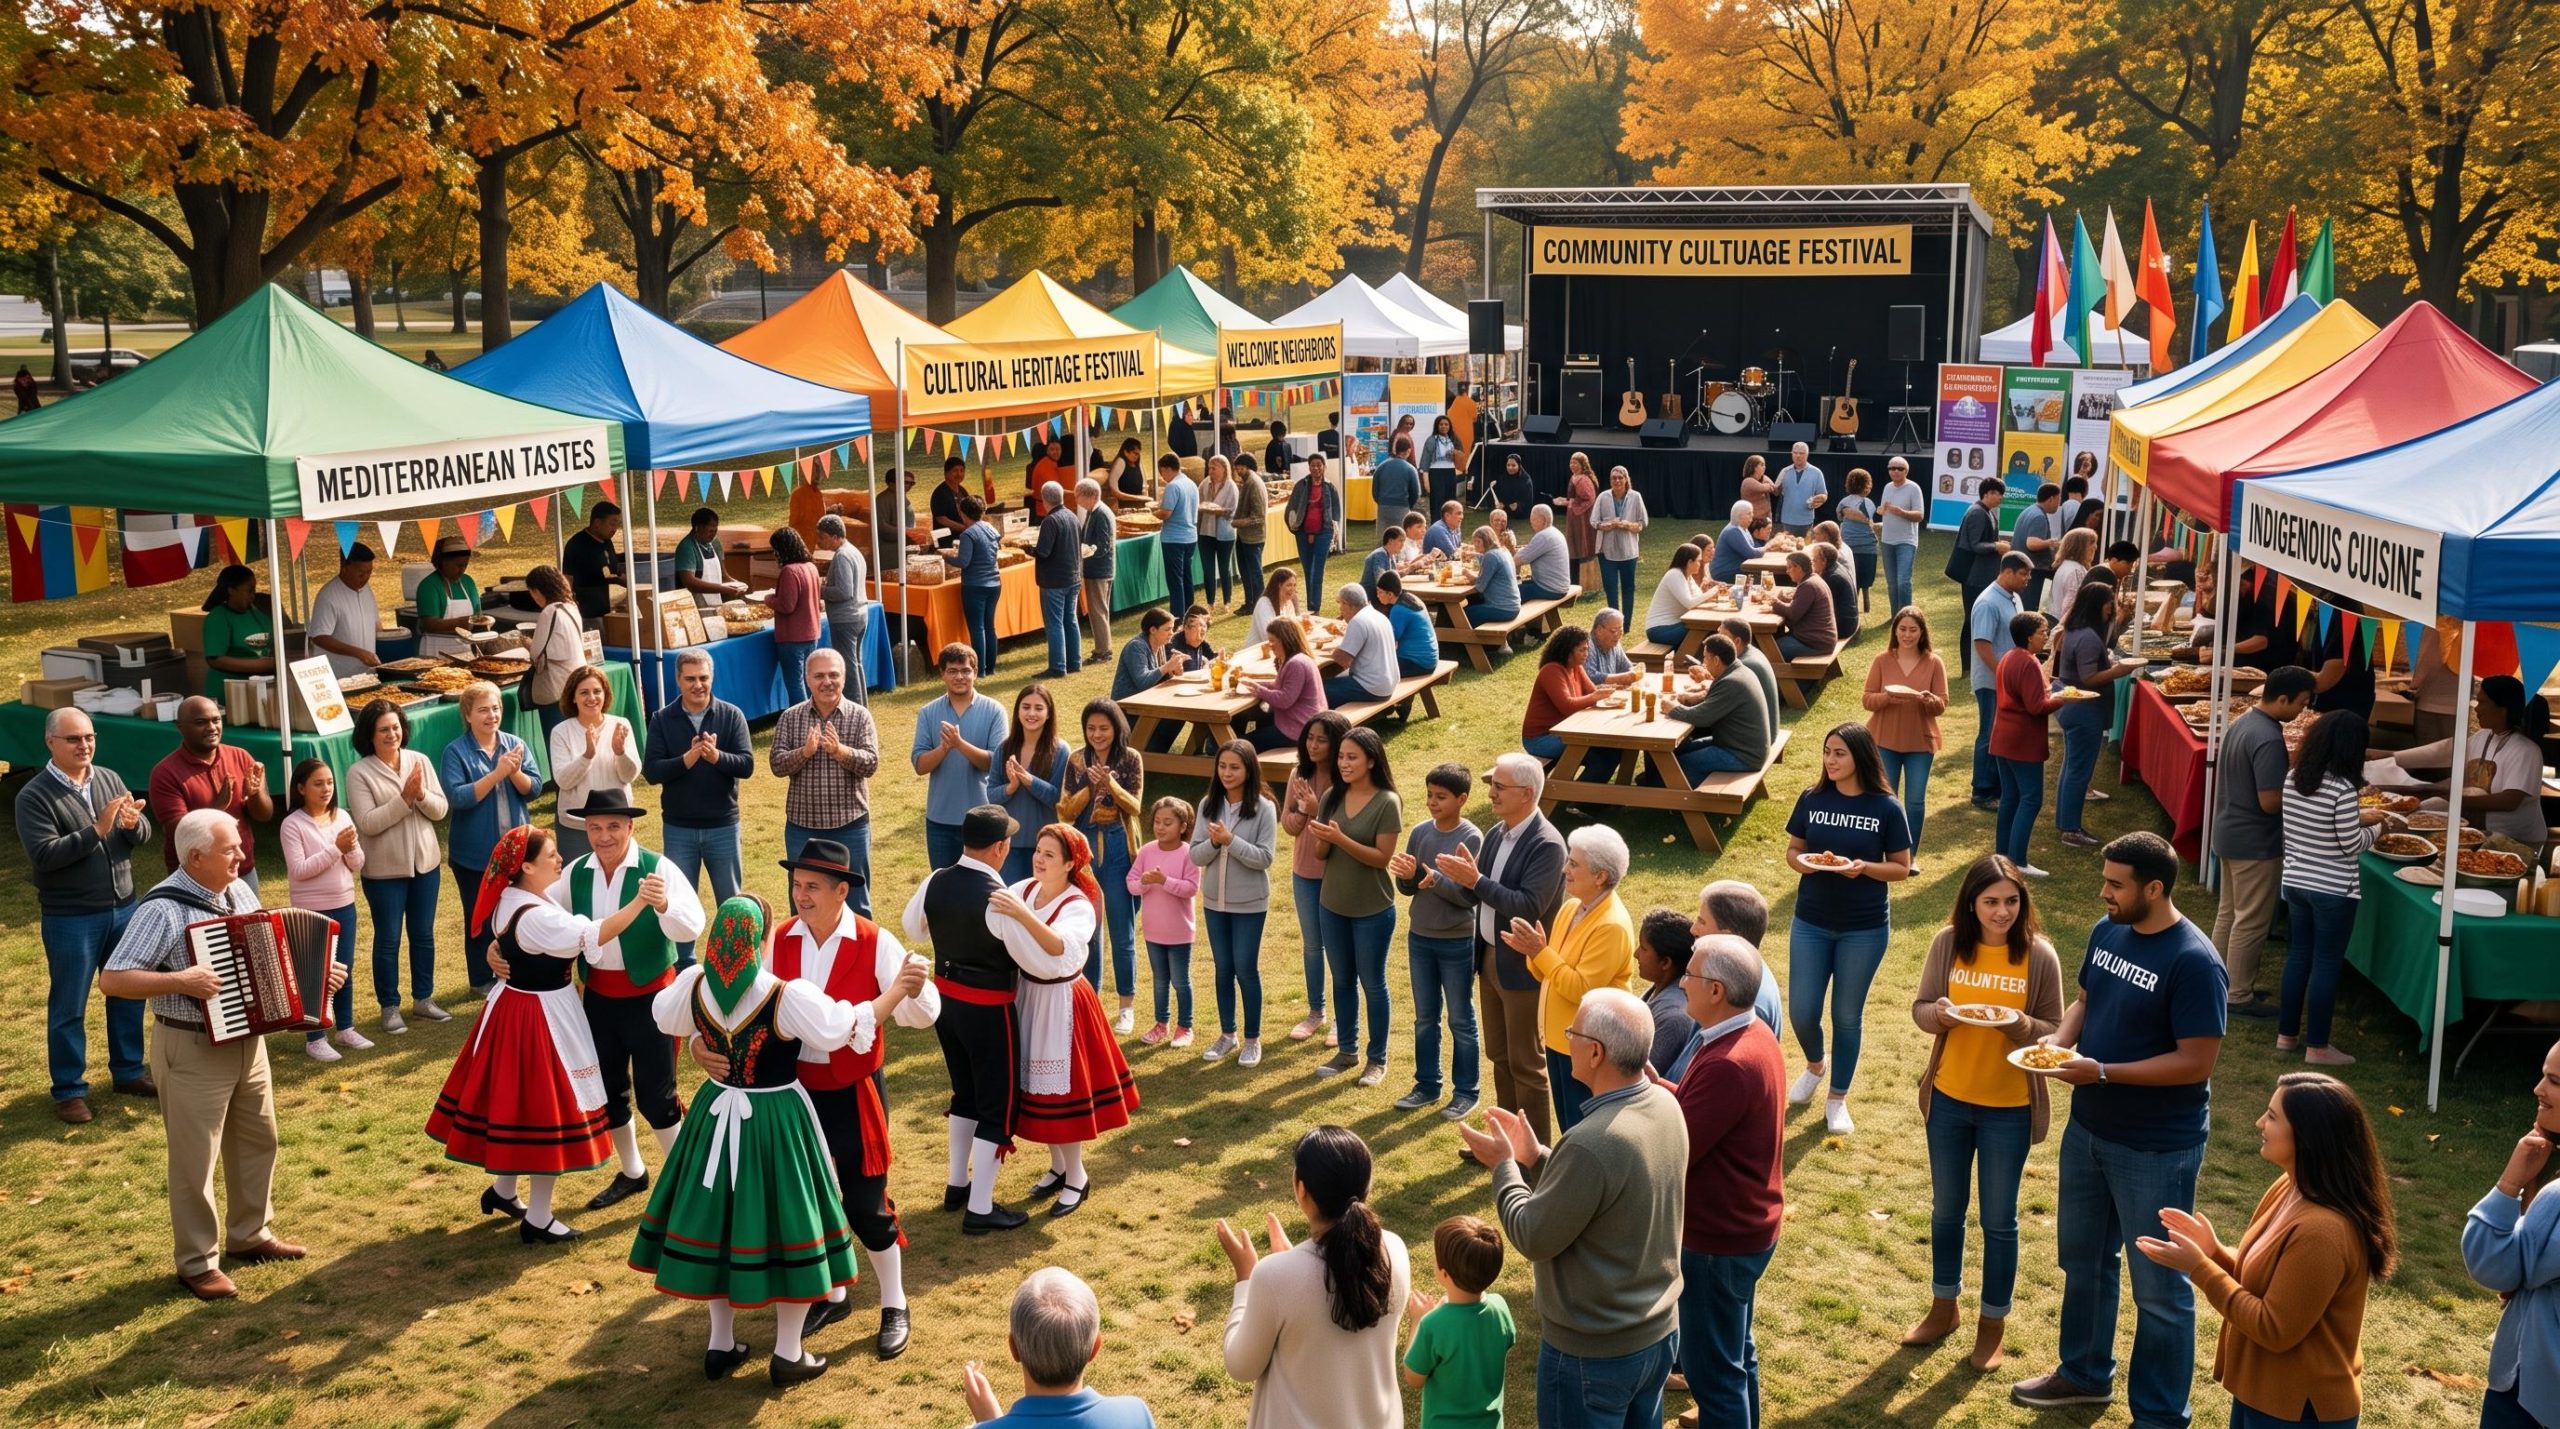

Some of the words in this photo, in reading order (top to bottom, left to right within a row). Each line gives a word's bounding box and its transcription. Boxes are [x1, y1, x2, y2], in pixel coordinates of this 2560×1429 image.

[1543, 239, 1673, 265] COMMUNITY
[1679, 239, 1791, 266] CULTUAGE
[1798, 238, 1902, 265] FESTIVAL
[924, 360, 1007, 395] CULTURAL
[1012, 354, 1082, 389] HERITAGE
[1085, 349, 1145, 382] FESTIVAL
[1226, 341, 1280, 368] WELCOME
[1281, 336, 1336, 364] NEIGHBORS
[316, 448, 516, 503] MEDITERRANEAN
[520, 439, 596, 477] TASTES
[2249, 502, 2342, 574] INDIGENOUS
[2347, 530, 2425, 600] CUISINE
[1809, 810, 1880, 833] VOLUNTEER
[2091, 946, 2159, 992] VOLUNTEER
